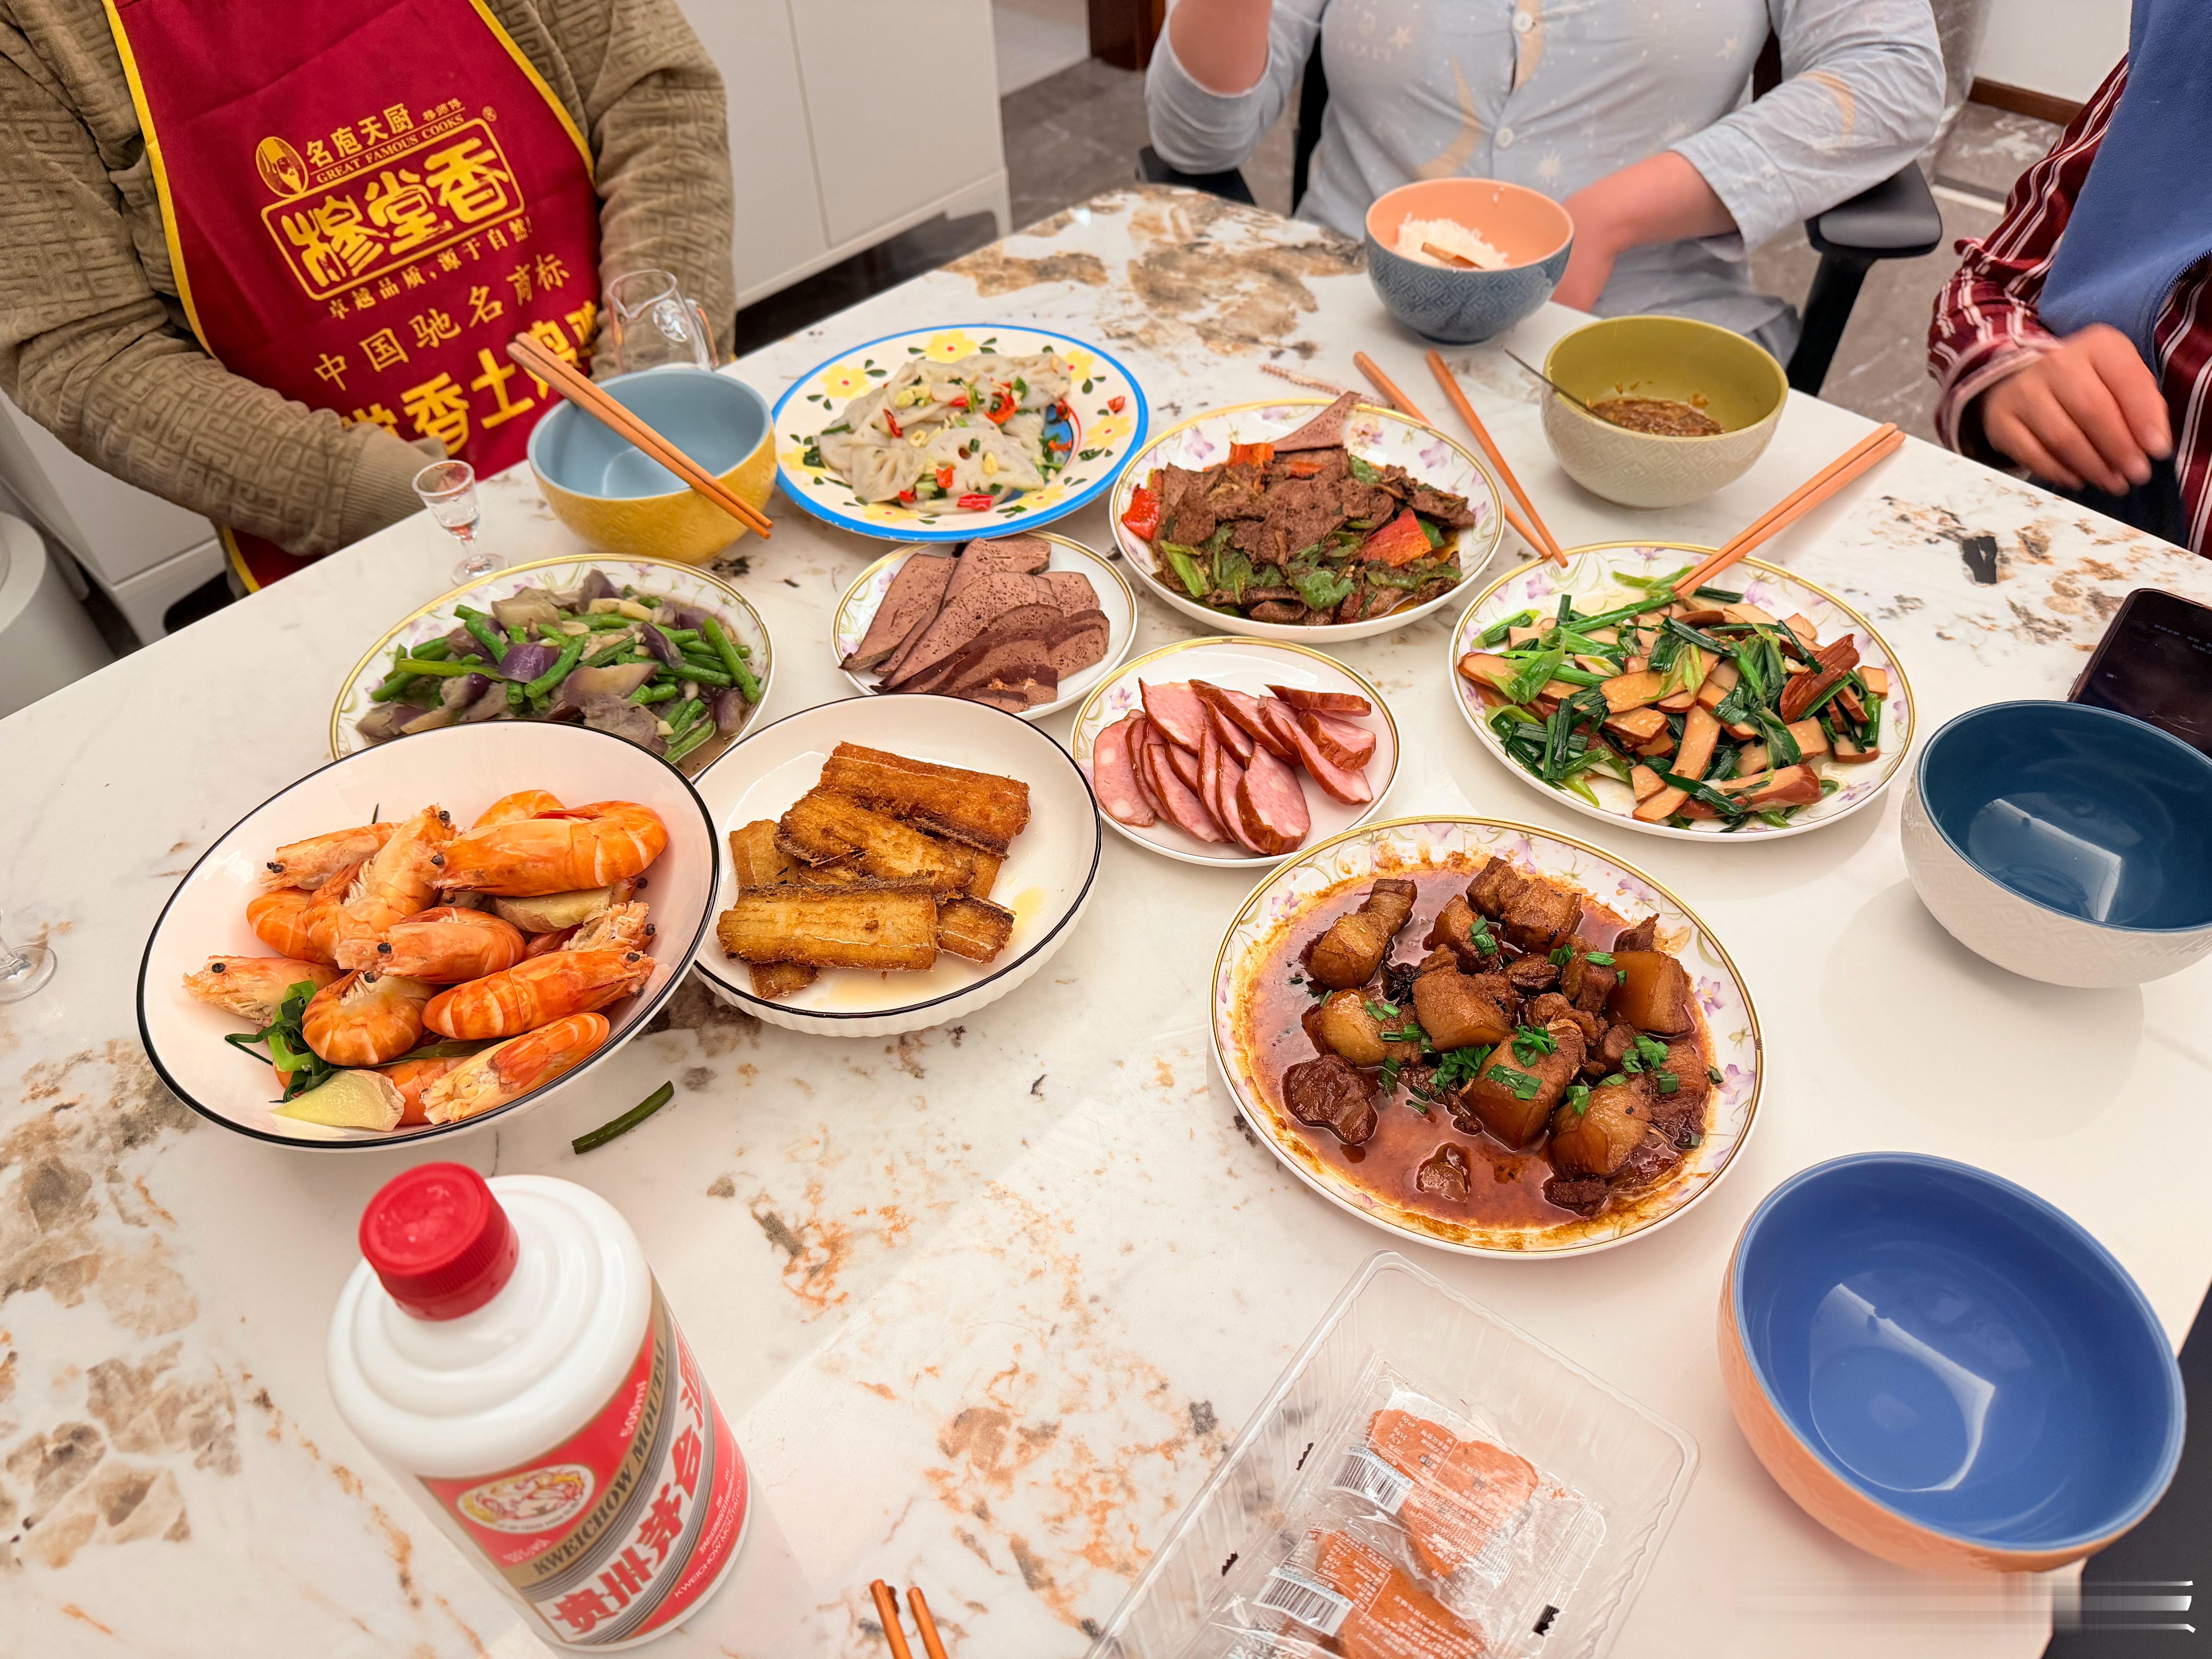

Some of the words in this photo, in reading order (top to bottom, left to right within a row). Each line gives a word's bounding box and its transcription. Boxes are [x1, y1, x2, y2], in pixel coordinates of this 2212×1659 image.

[307, 103, 414, 167] 名庖天厨
[317, 158, 360, 183] GREAT
[365, 134, 419, 163] FAMOUS
[421, 114, 464, 139] COOKS
[314, 253, 570, 391] 中国驰名商标
[620, 1379, 648, 1438] 500ml
[1388, 1432, 1403, 1446] 4.7g
[1392, 1426, 1408, 1440] 31.9g
[1400, 1414, 1417, 1429] 49.0g
[534, 1462, 632, 1575] KWEICHOW
[631, 1341, 665, 1465] MOUTAI
[551, 1318, 704, 1635] 贵州茅台酒
[673, 1540, 723, 1597] KWEICHOW
[720, 1497, 738, 1542] MOUTAI
